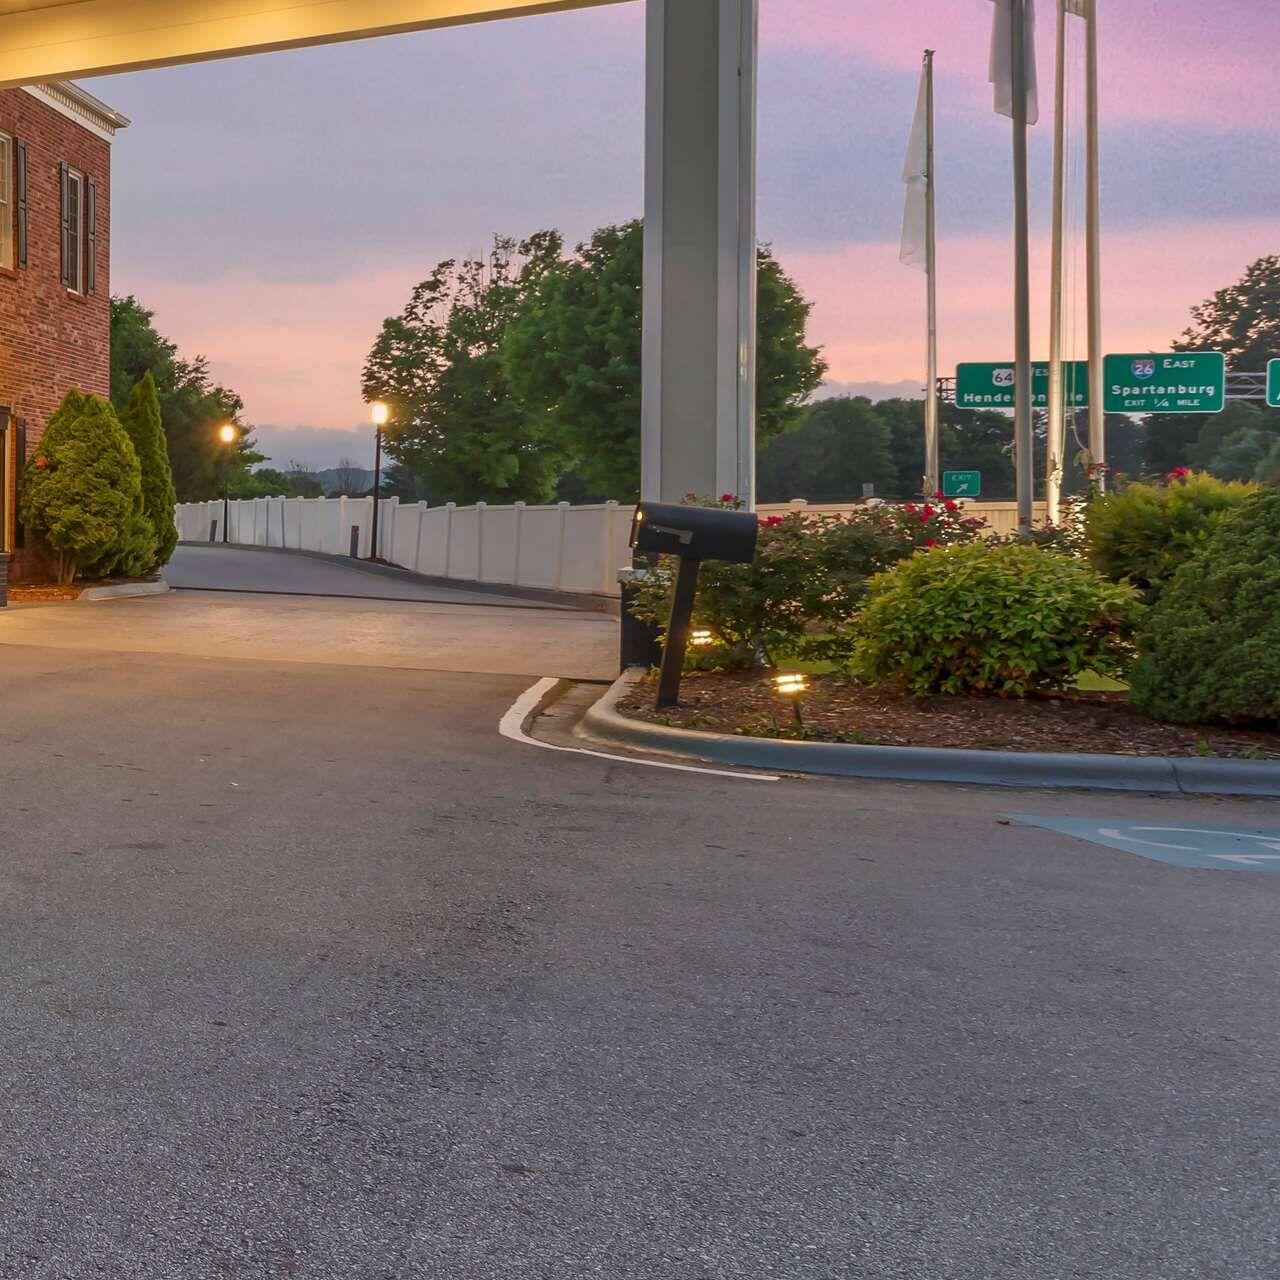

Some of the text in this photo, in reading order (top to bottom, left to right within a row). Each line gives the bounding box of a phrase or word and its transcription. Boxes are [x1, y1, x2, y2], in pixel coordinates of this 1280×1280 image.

[1135, 364, 1153, 375] 26
[994, 372, 1013, 383] 64
[1111, 384, 1216, 397] Spartanburg
[1124, 399, 1146, 407] EXIT
[1177, 399, 1200, 407] MILE
